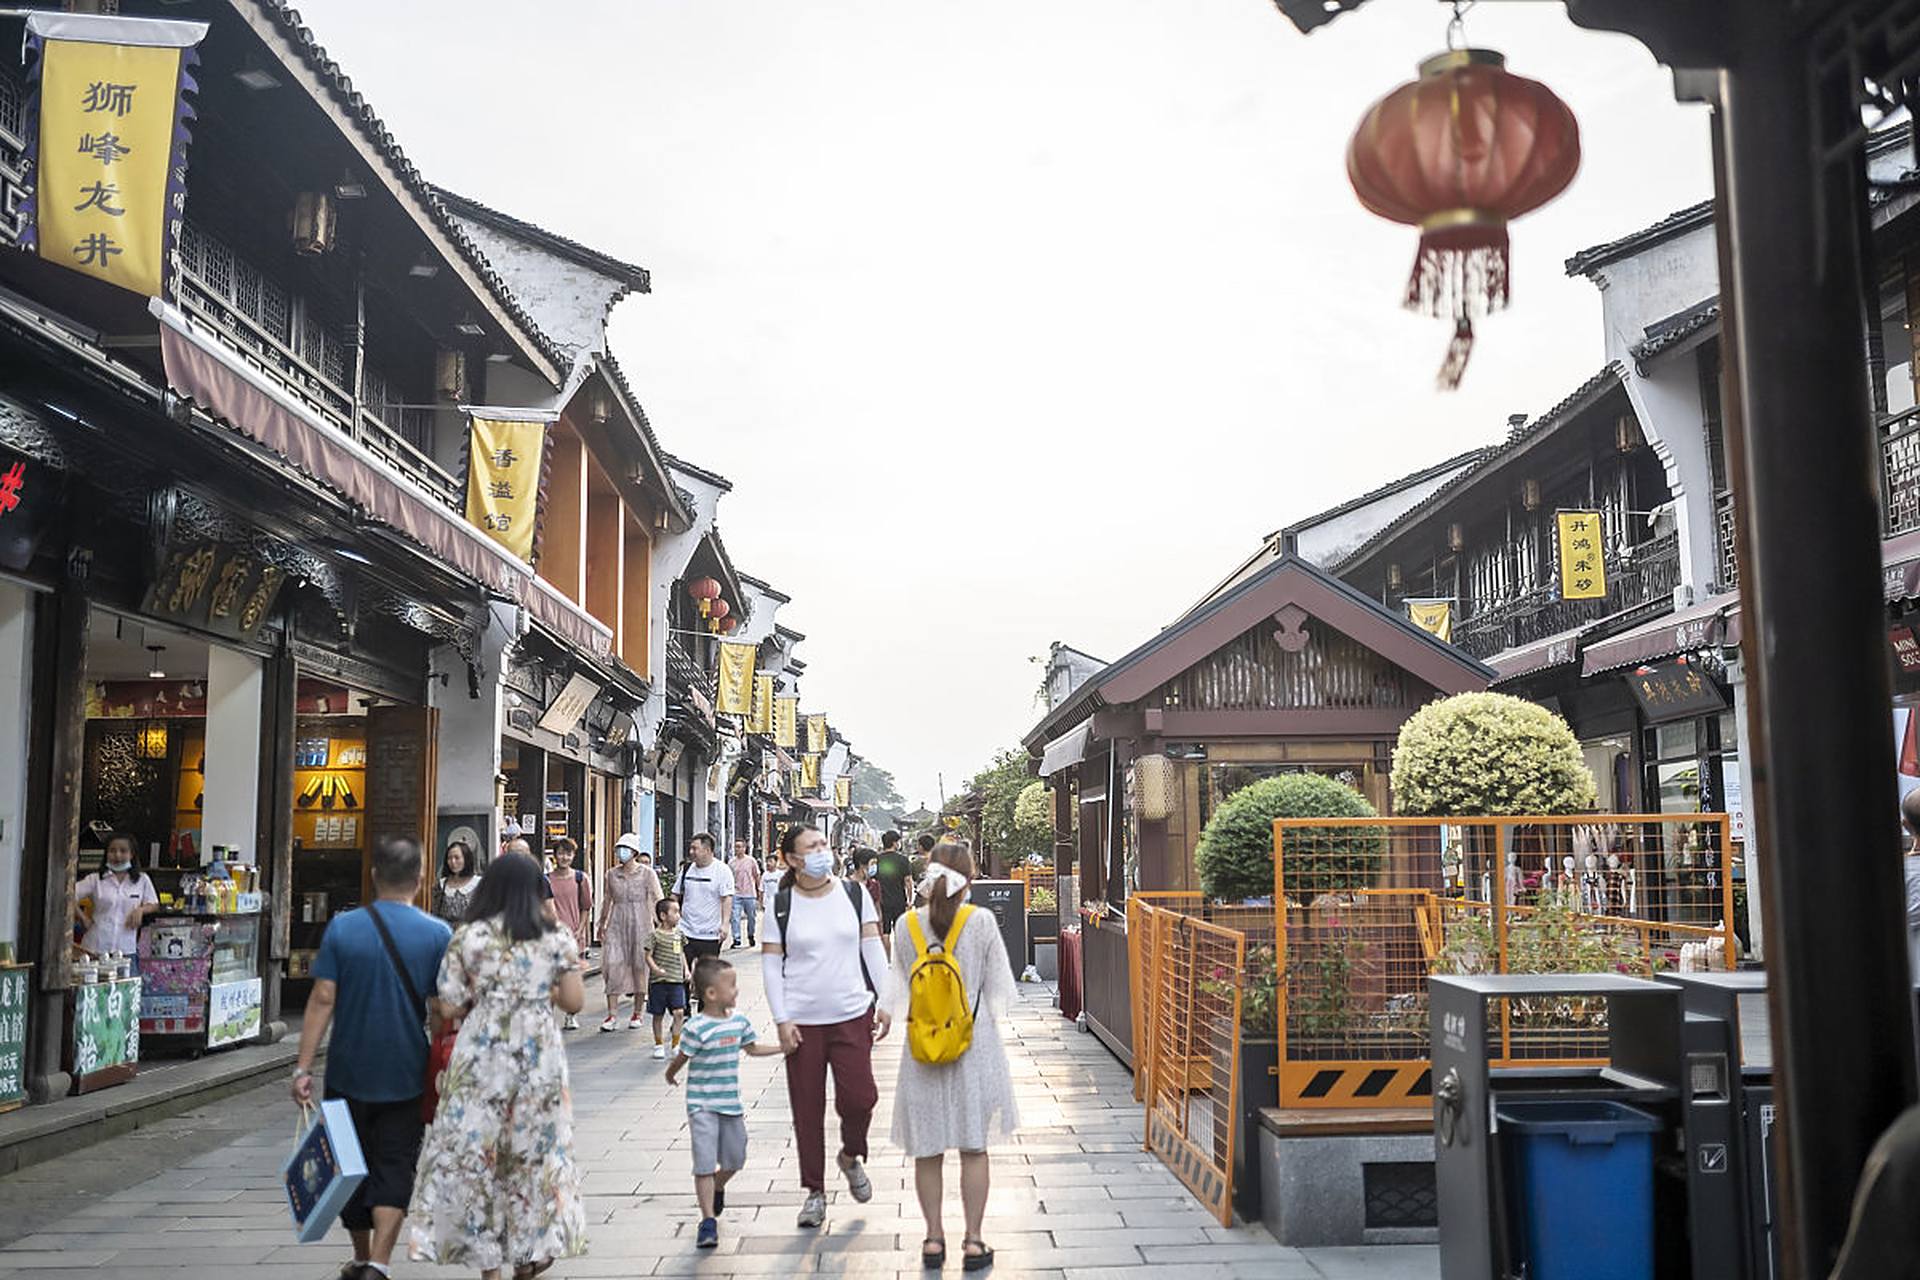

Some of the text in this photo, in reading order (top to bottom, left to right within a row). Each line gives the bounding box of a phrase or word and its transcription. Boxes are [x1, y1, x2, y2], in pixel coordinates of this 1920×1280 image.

[73, 81, 137, 268] 狮峰龙井
[483, 449, 518, 532] 香溢馆
[1570, 520, 1593, 592] 丹鸿朱砂
